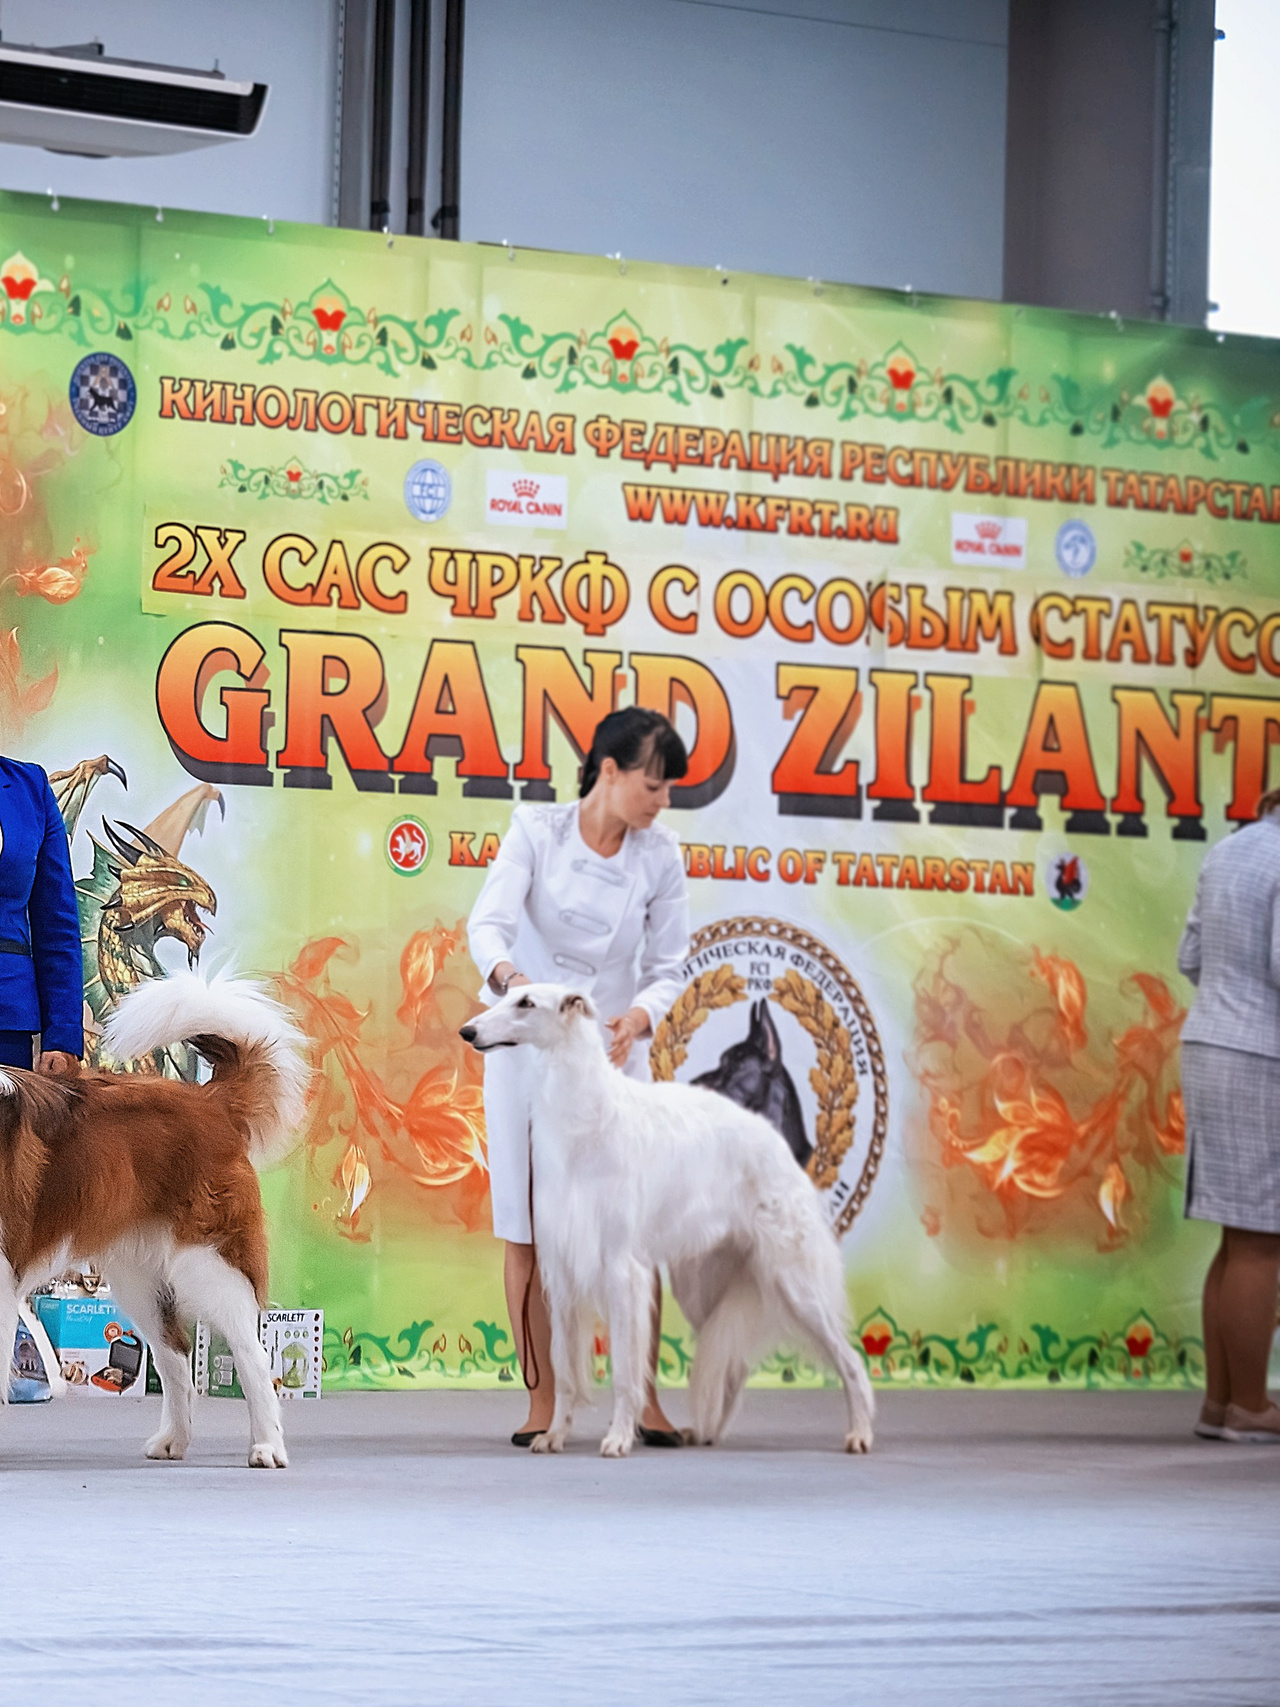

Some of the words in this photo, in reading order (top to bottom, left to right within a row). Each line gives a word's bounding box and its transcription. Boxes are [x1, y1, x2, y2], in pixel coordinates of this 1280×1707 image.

[159, 376, 576, 455] КИНОЛОГИЧЕСКАЯ
[584, 415, 833, 482] ФЕДЕРАЦИЯ
[840, 442, 1096, 505] РЕСПУБЛИКИ
[490, 499, 524, 514] ROYAL
[526, 502, 563, 516] CANIN
[622, 482, 900, 545] WWW.KFRT.RU
[427, 546, 631, 638] ЧРКФ
[648, 562, 700, 635] С
[154, 621, 736, 809] GRAND
[769, 661, 1280, 842] ZILANT
[777, 847, 827, 885] OF
[832, 851, 1036, 897] TATARSTAN
[747, 977, 773, 992] РКФ
[749, 961, 771, 976] FCI
[790, 953, 869, 1077] ФЕДЕРАЦИЯ
[266, 1313, 305, 1322] SCARLETT
